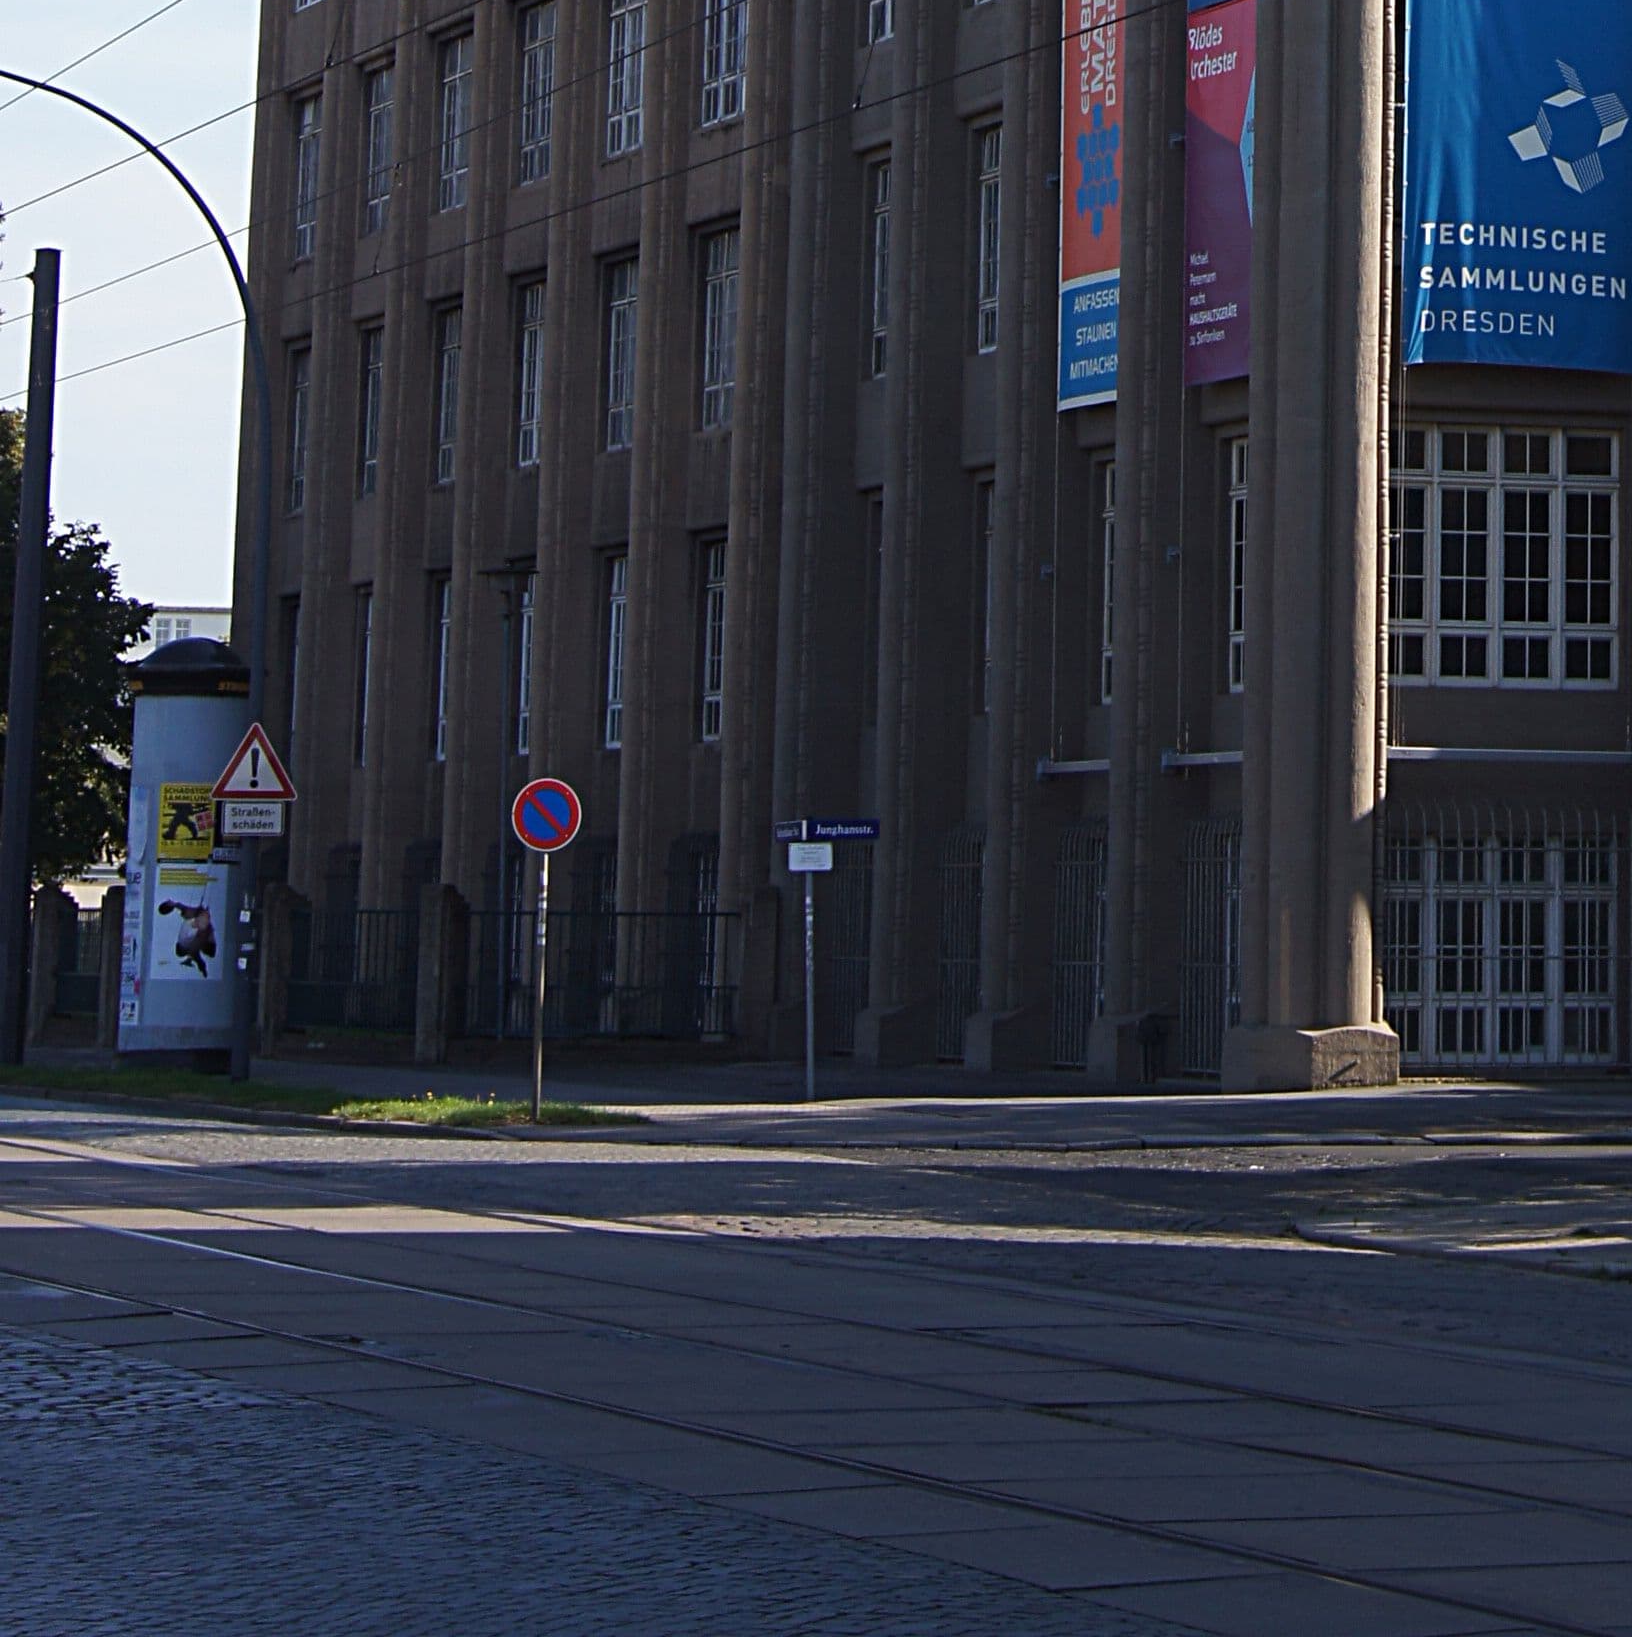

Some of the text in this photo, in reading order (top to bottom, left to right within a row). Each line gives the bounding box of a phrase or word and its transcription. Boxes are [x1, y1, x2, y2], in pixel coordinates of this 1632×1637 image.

[1420, 223, 1607, 254] TECHNISCHE
[1419, 266, 1626, 300] SAMMLUNGEN
[1075, 321, 1117, 347] STAUNEN
[1420, 309, 1555, 336] DRESDEN
[816, 823, 874, 836] Junghansstr.
